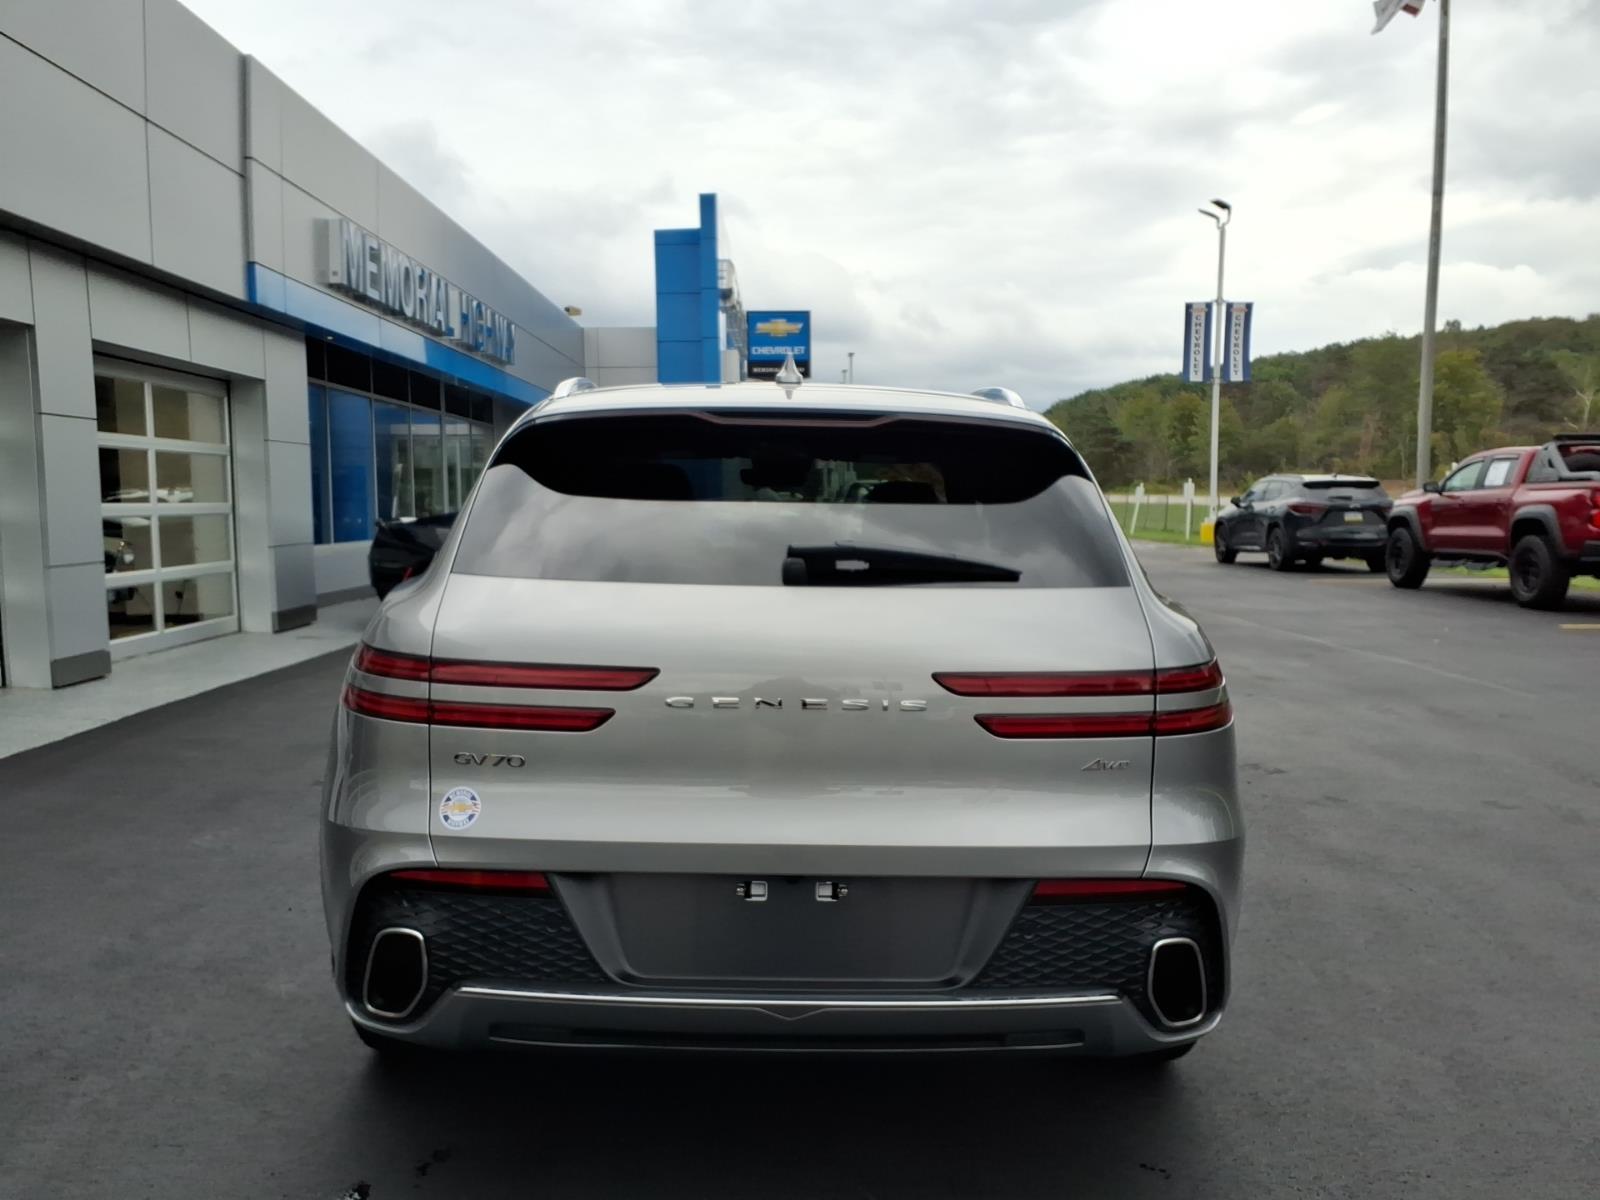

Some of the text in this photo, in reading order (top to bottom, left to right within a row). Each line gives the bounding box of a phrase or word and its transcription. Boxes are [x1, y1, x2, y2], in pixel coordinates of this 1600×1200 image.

[751, 346, 805, 355] CHEVROLET
[1193, 315, 1203, 376] CHEVROLET
[1232, 315, 1242, 376] CHEVROLET
[665, 696, 928, 712] GENESIS
[453, 751, 526, 768] GV70
